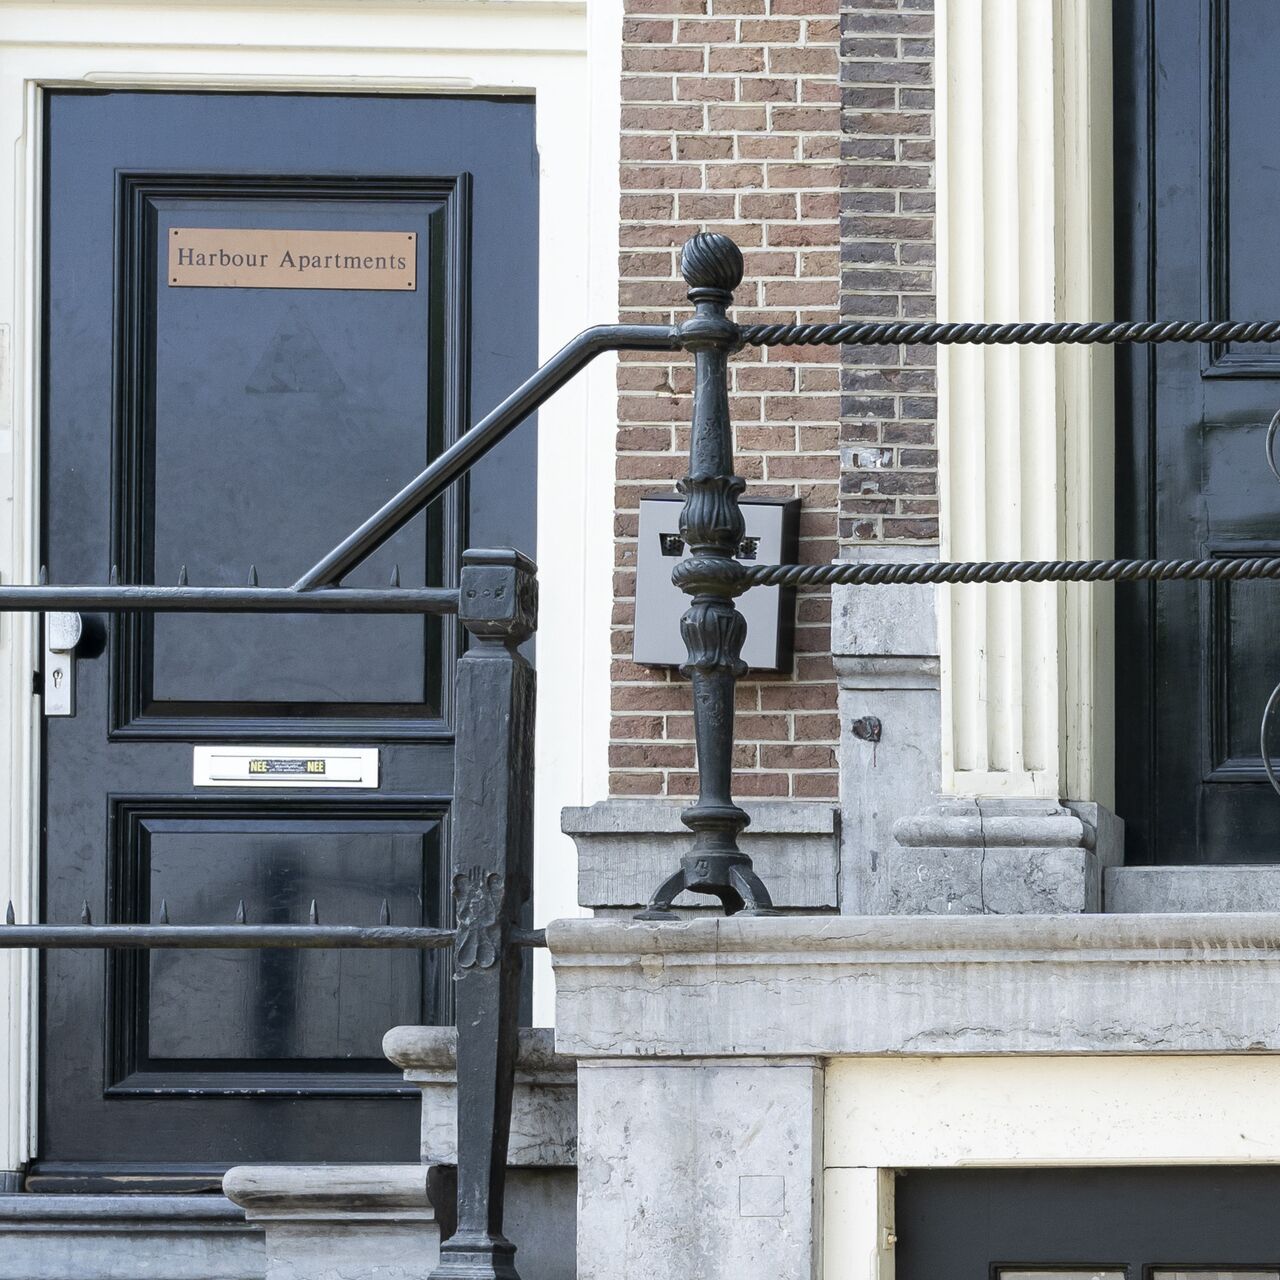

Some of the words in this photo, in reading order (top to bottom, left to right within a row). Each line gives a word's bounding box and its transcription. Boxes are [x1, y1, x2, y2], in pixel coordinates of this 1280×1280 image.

[177, 247, 269, 268] Harbour
[279, 250, 406, 272] Apartments
[250, 761, 267, 772] NEE
[307, 761, 324, 772] NEE
